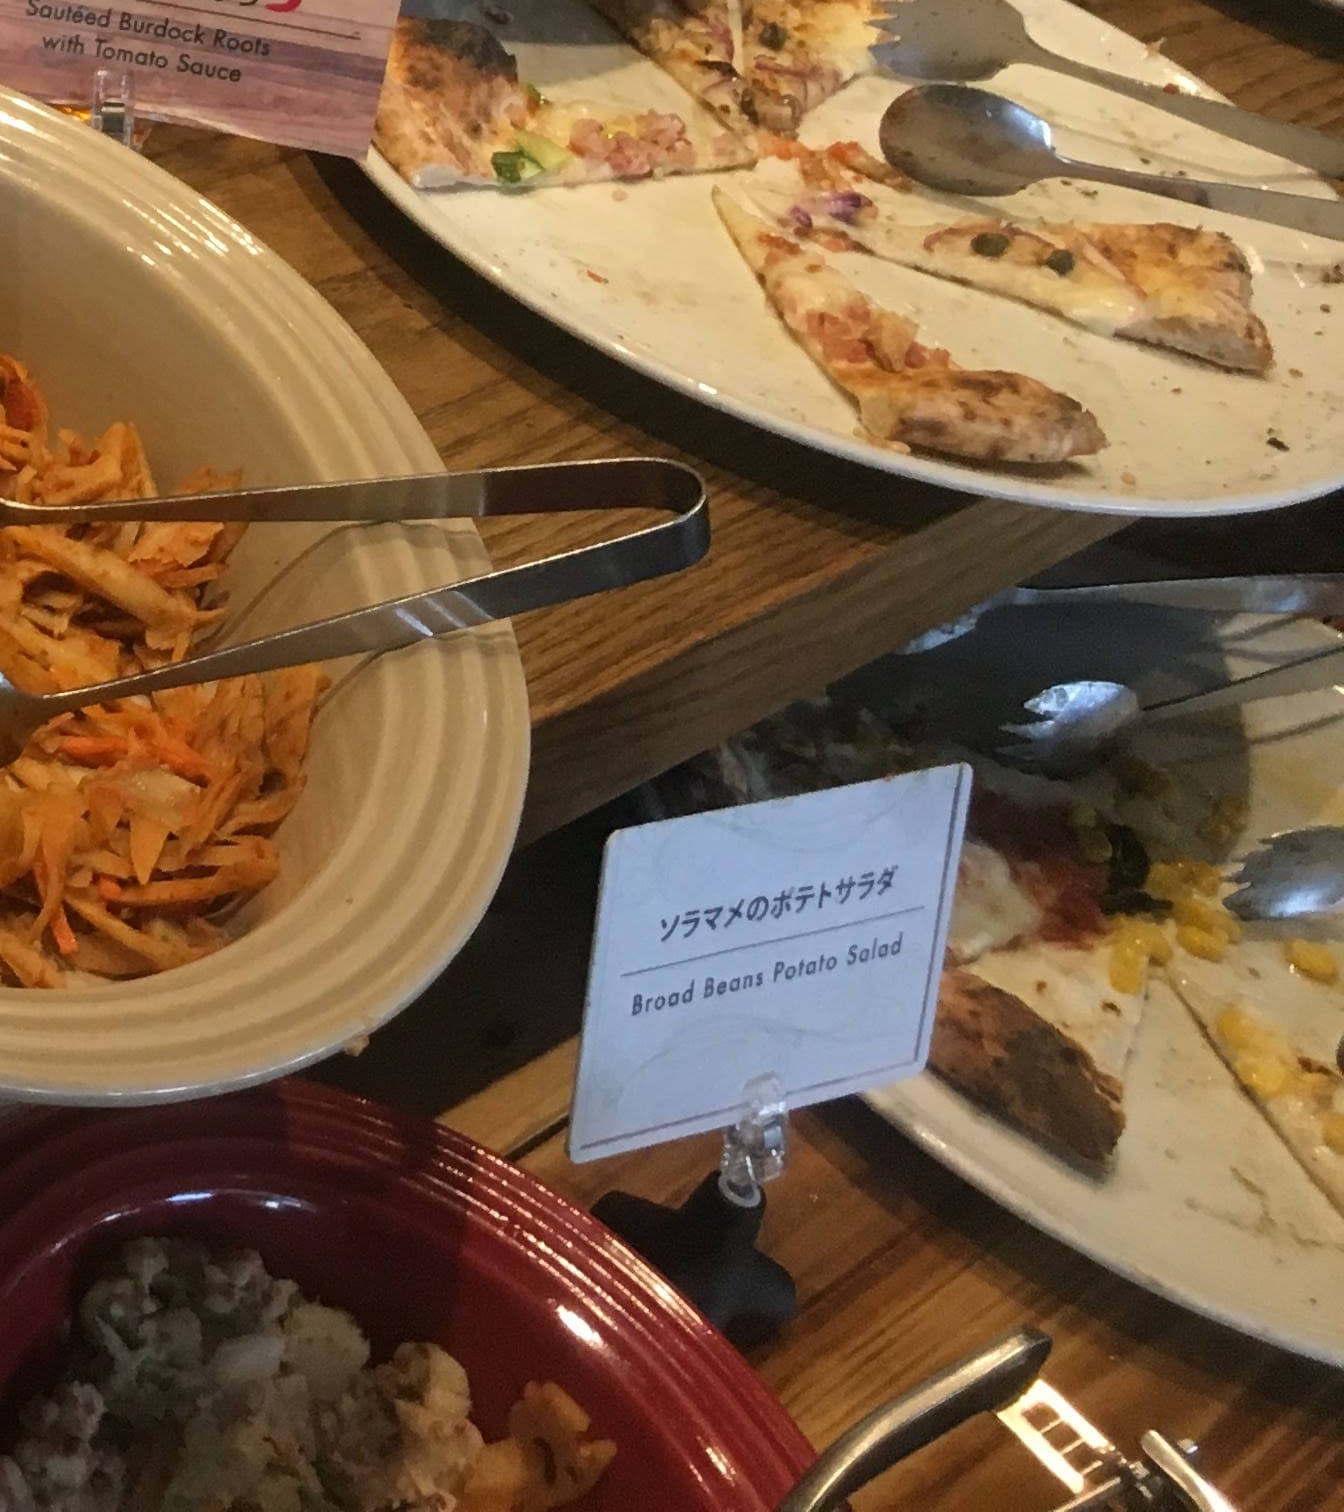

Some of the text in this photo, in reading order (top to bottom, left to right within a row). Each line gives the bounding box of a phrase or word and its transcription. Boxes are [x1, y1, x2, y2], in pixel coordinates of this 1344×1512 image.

[42, 32, 242, 83] with Tomato Sauce
[119, 11, 206, 46] Burdock
[213, 29, 271, 57] Roots
[659, 864, 900, 943] ソラマメのポテトサラダ
[631, 932, 903, 1016] Broad Beans Potato Salad
